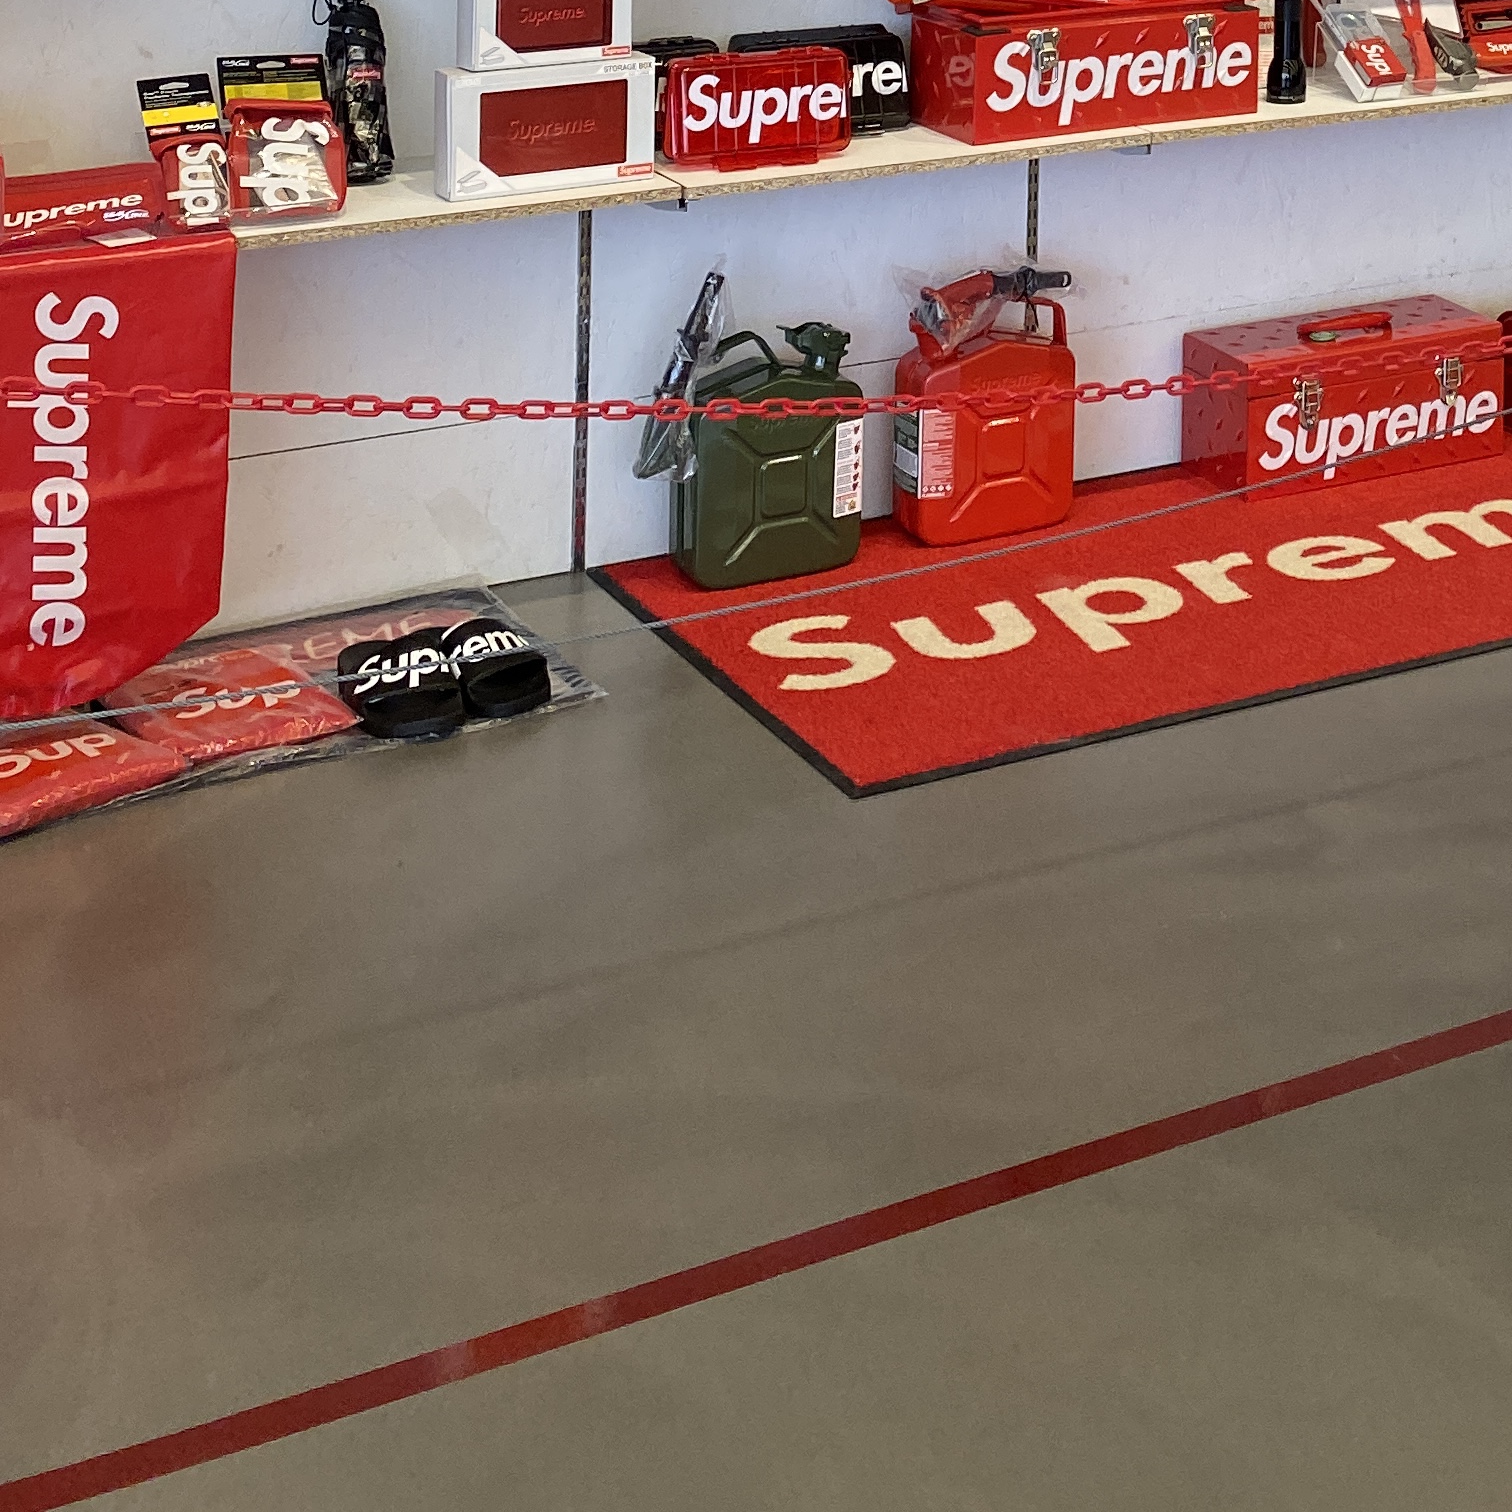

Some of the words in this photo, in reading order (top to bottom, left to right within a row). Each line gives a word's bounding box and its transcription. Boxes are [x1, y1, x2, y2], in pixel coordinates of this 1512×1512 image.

[519, 6, 586, 27] Supreme
[604, 63, 636, 73] STORAGE
[639, 61, 653, 70] BOX
[985, 41, 1252, 126] Supreme
[510, 118, 598, 144] Supreme
[3, 194, 144, 230] upreme
[167, 142, 227, 226] Sup
[1258, 388, 1499, 480] Supreme
[8, 290, 120, 647] Supreme
